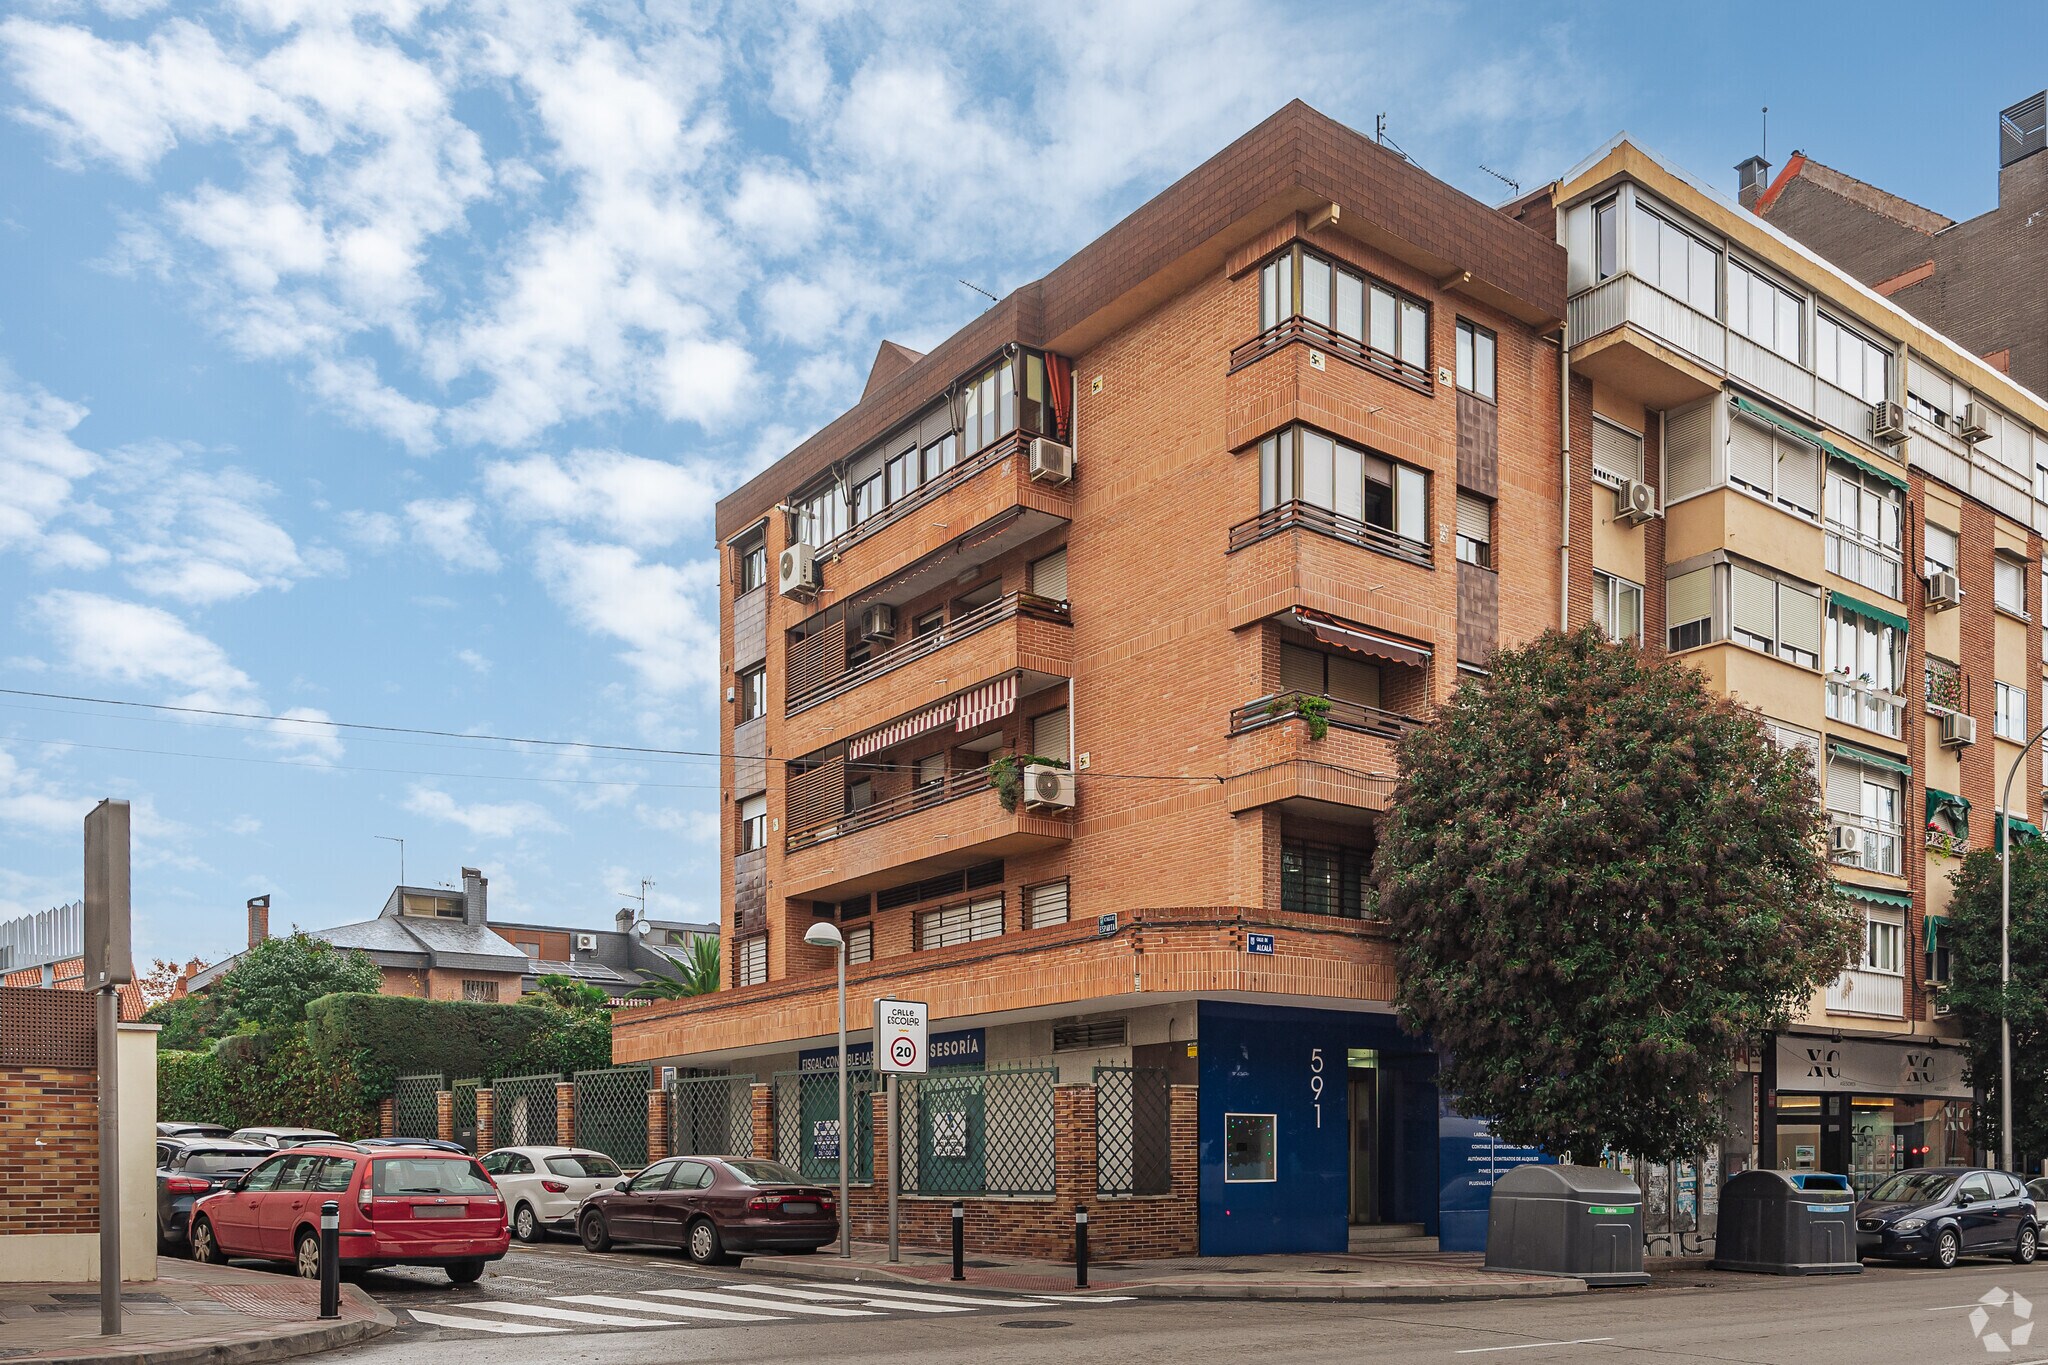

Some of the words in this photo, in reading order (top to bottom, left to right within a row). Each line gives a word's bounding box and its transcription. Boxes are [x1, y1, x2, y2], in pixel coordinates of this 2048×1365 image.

[1256, 944, 1273, 952] ALCALÁ
[887, 1015, 920, 1027] ESCOLAR
[895, 1046, 912, 1058] 20
[930, 1035, 979, 1058] SESORÍA
[802, 1057, 823, 1071] FISCAL
[825, 1053, 860, 1068] CONBLE
[1310, 1048, 1324, 1129] 591
